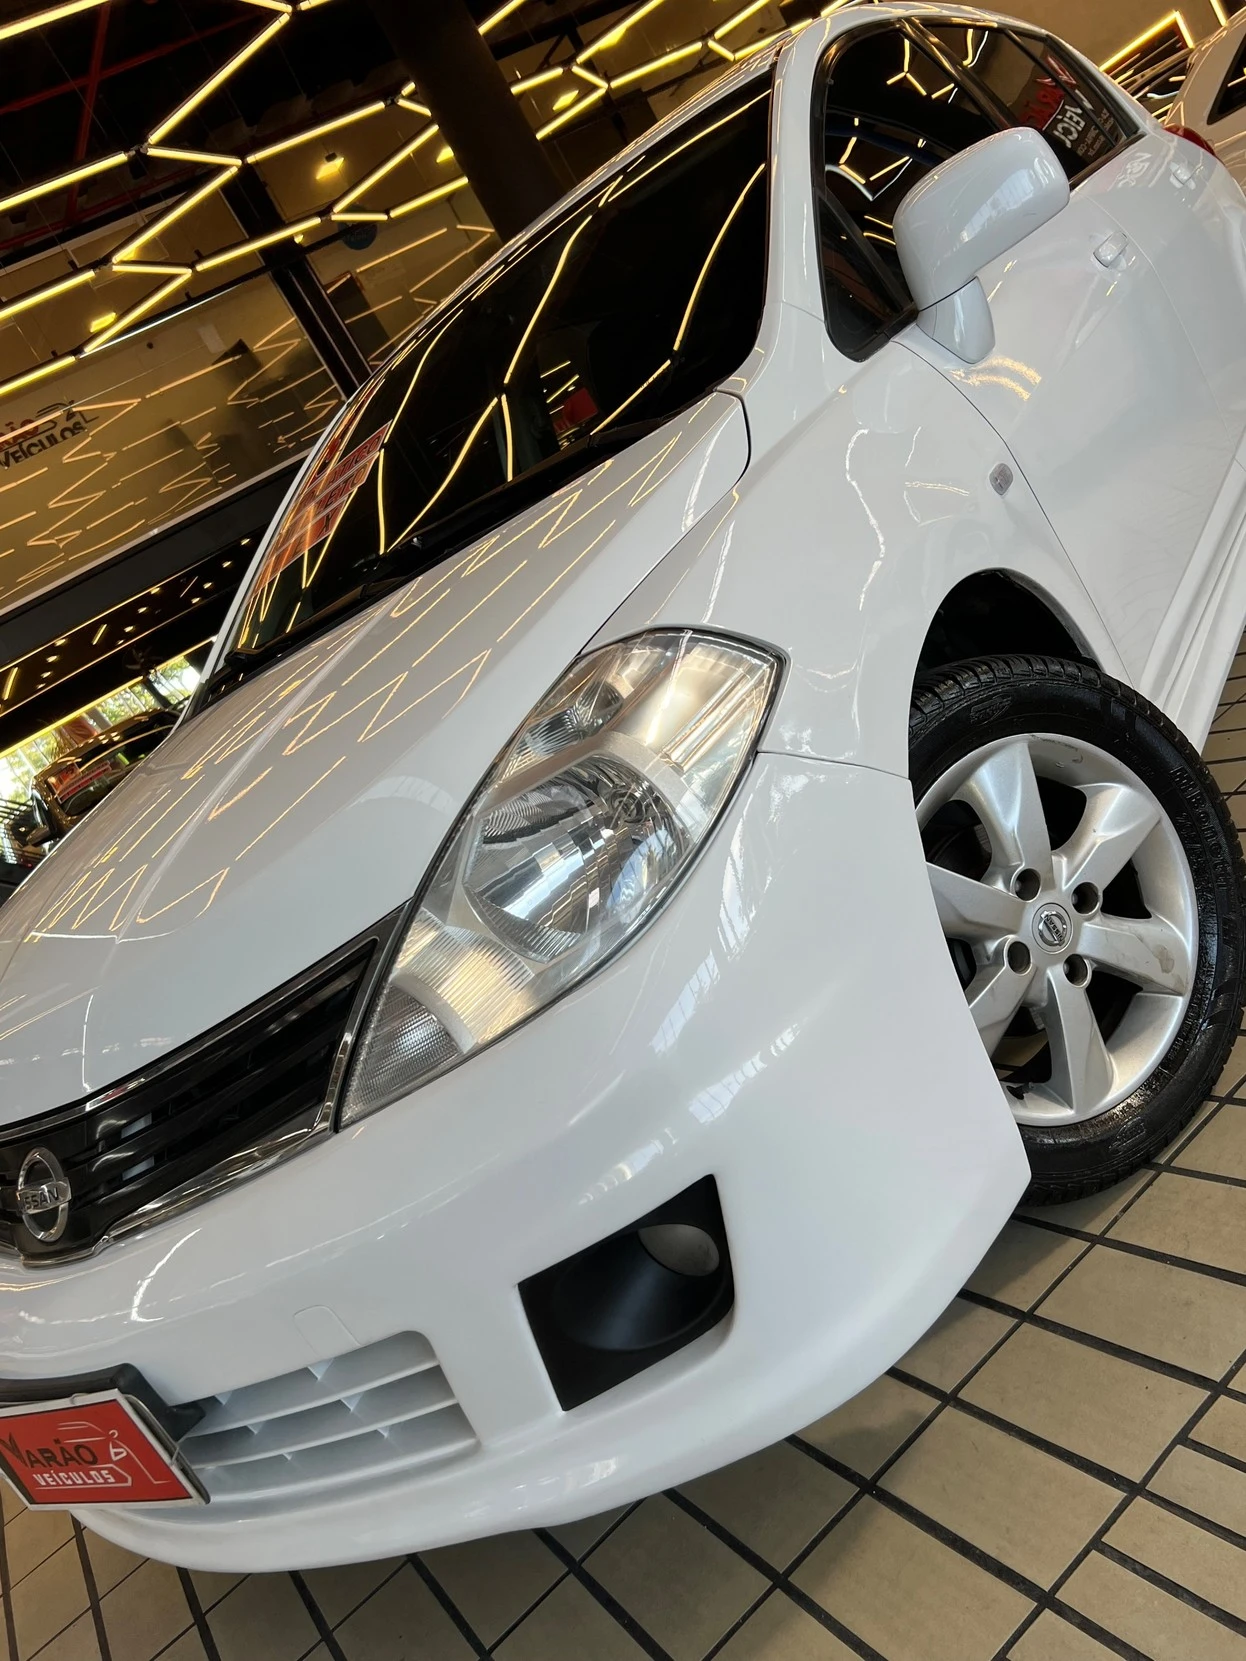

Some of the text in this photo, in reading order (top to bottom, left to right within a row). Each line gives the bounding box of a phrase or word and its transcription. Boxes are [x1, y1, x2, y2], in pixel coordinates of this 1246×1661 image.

[22, 1187, 60, 1210] SSAN
[0, 1432, 98, 1468] VARÃO
[33, 1469, 117, 1486] VEÍCULOS
